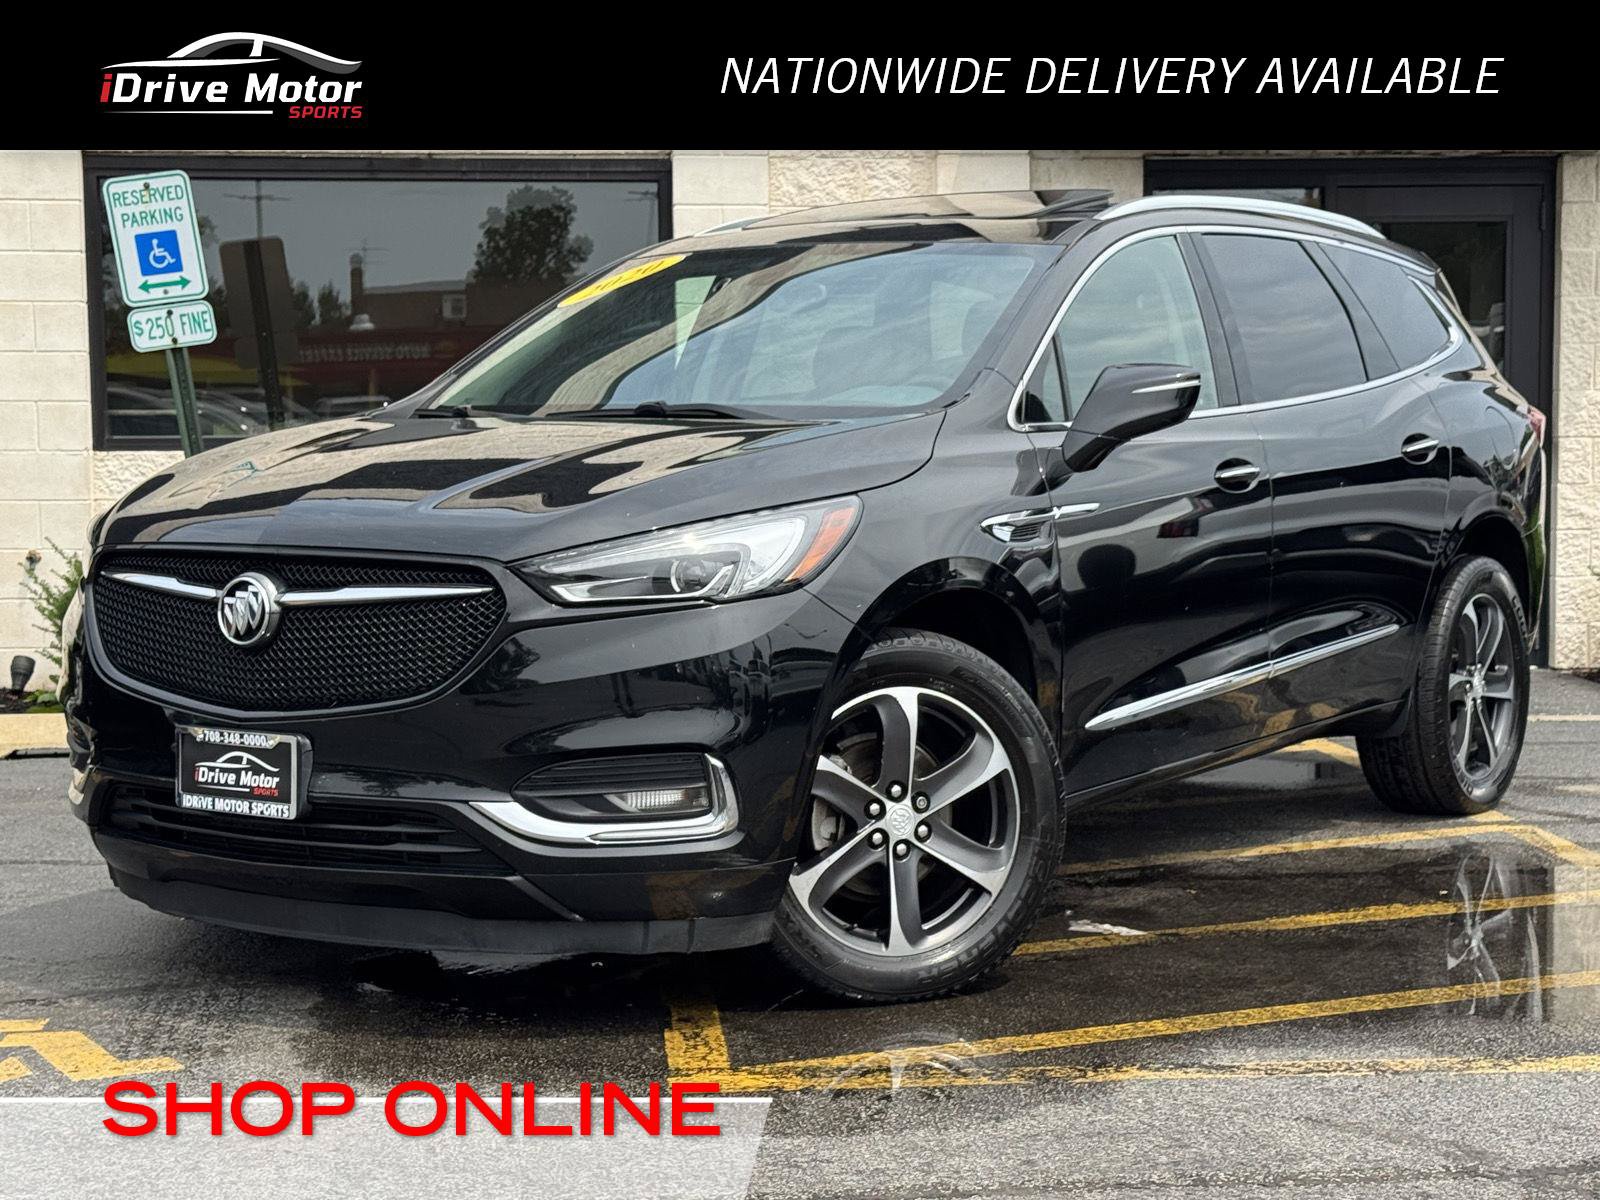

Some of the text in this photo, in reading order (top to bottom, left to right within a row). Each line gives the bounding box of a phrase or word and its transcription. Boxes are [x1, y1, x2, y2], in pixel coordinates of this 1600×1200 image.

[112, 184, 184, 208] RESERVED
[120, 206, 184, 229] PARKING
[179, 310, 212, 336] FINE
[204, 730, 267, 747] 708-348-0000
[194, 766, 280, 789] iDrive Motor
[253, 787, 279, 797] SPORTS
[214, 797, 250, 814] MOTOR
[251, 801, 289, 818] SPORTS
